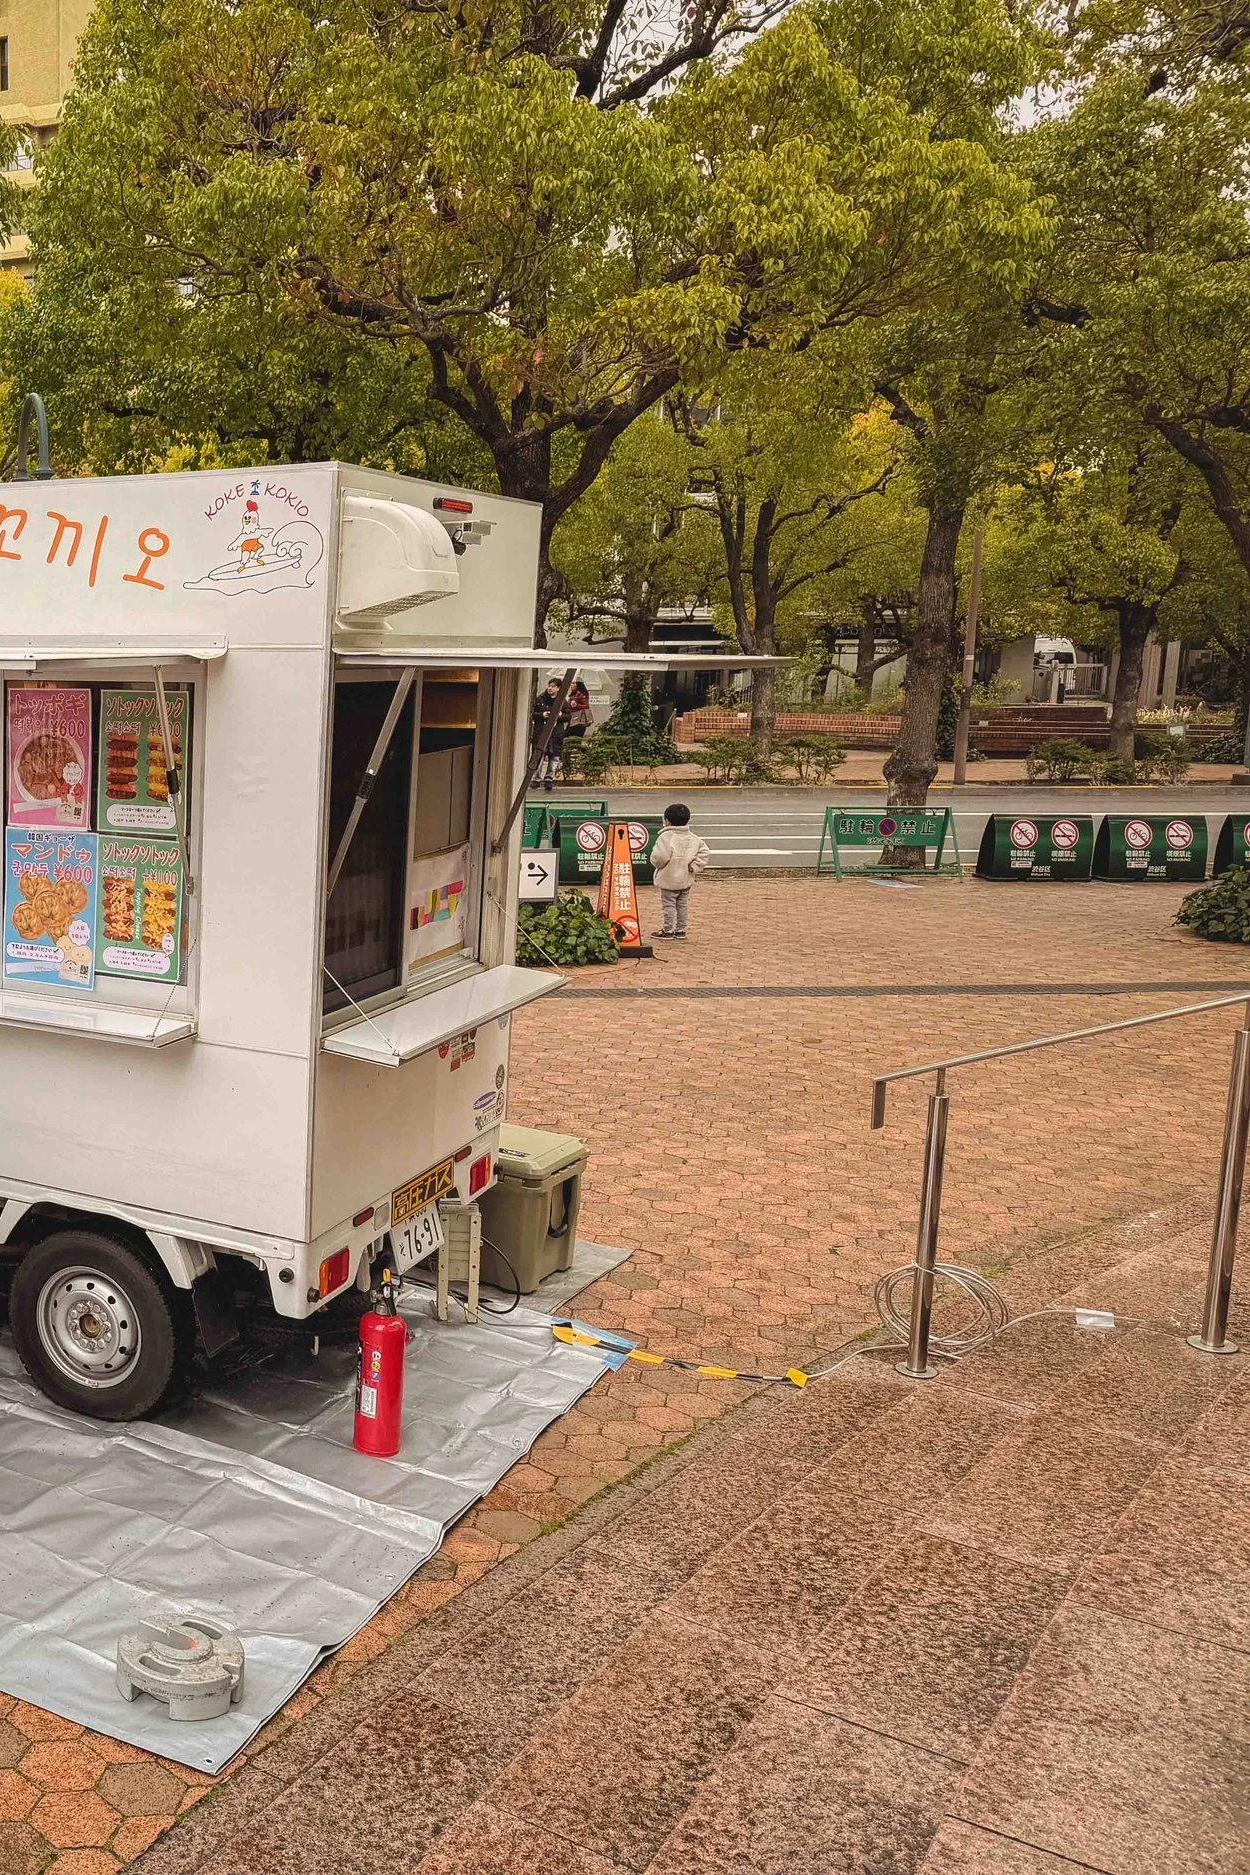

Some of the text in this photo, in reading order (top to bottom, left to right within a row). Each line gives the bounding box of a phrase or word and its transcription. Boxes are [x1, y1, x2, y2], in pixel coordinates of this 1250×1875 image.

[204, 483, 309, 521] KOKE KOKIO
[13, 693, 86, 716] トッポギ
[50, 719, 85, 738] ¥600
[27, 832, 76, 843] 韓国ギョーザ
[839, 819, 936, 835] 駐輪 禁止
[11, 843, 92, 864] マンドゥ
[102, 842, 180, 866] ソトックソトック
[53, 864, 93, 883] ¥600
[613, 863, 619, 873] NO
[619, 863, 631, 910] 駐輪禁止
[394, 1163, 452, 1219] 高圧ガス
[404, 1213, 440, 1260] 76-91
